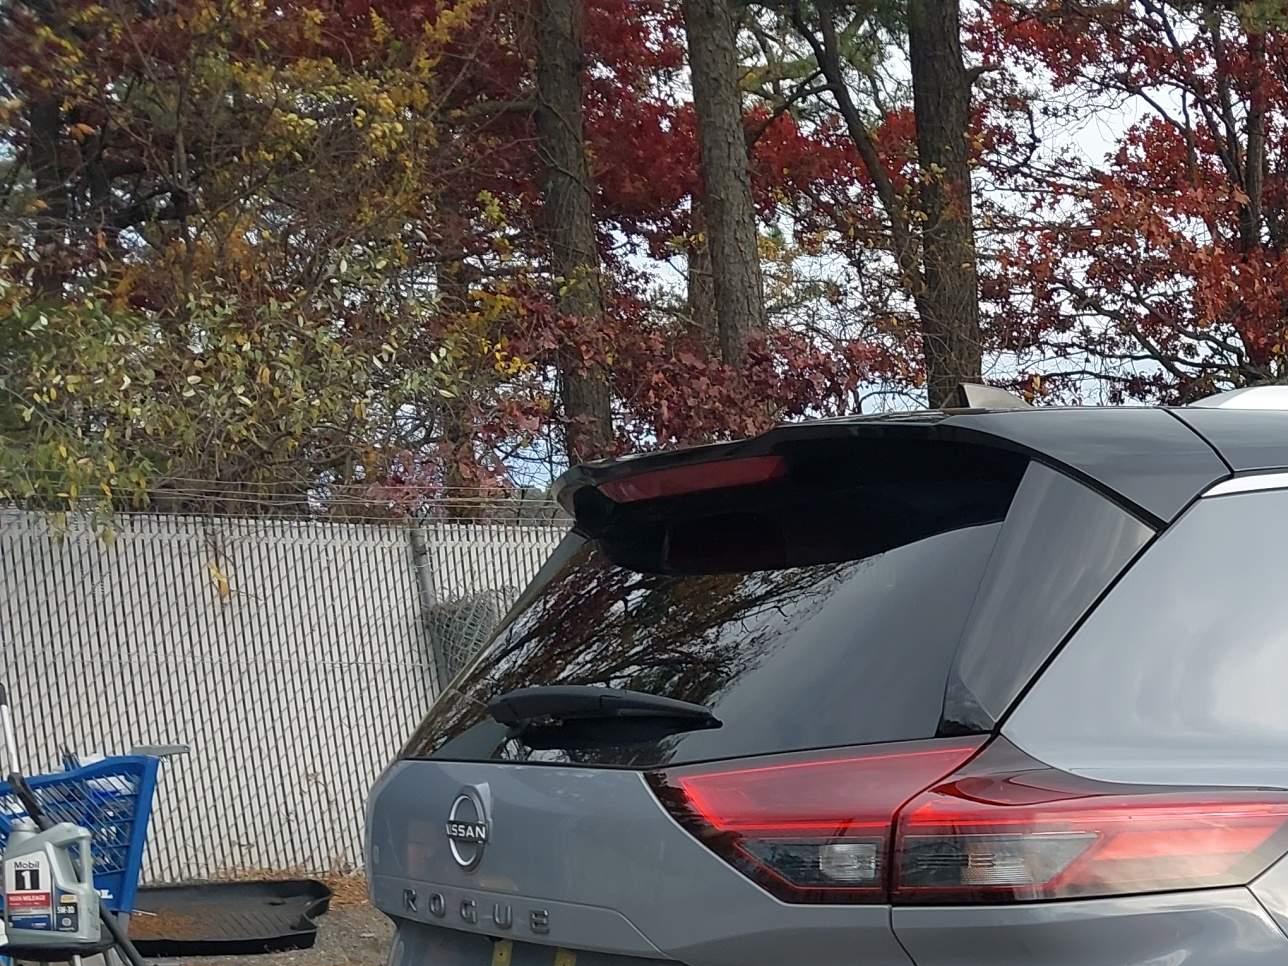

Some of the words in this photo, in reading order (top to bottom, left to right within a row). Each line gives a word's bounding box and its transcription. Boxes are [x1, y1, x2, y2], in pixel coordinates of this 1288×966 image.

[14, 861, 40, 869] Mobil
[21, 870, 32, 890] 1
[402, 887, 550, 934] ROGUE
